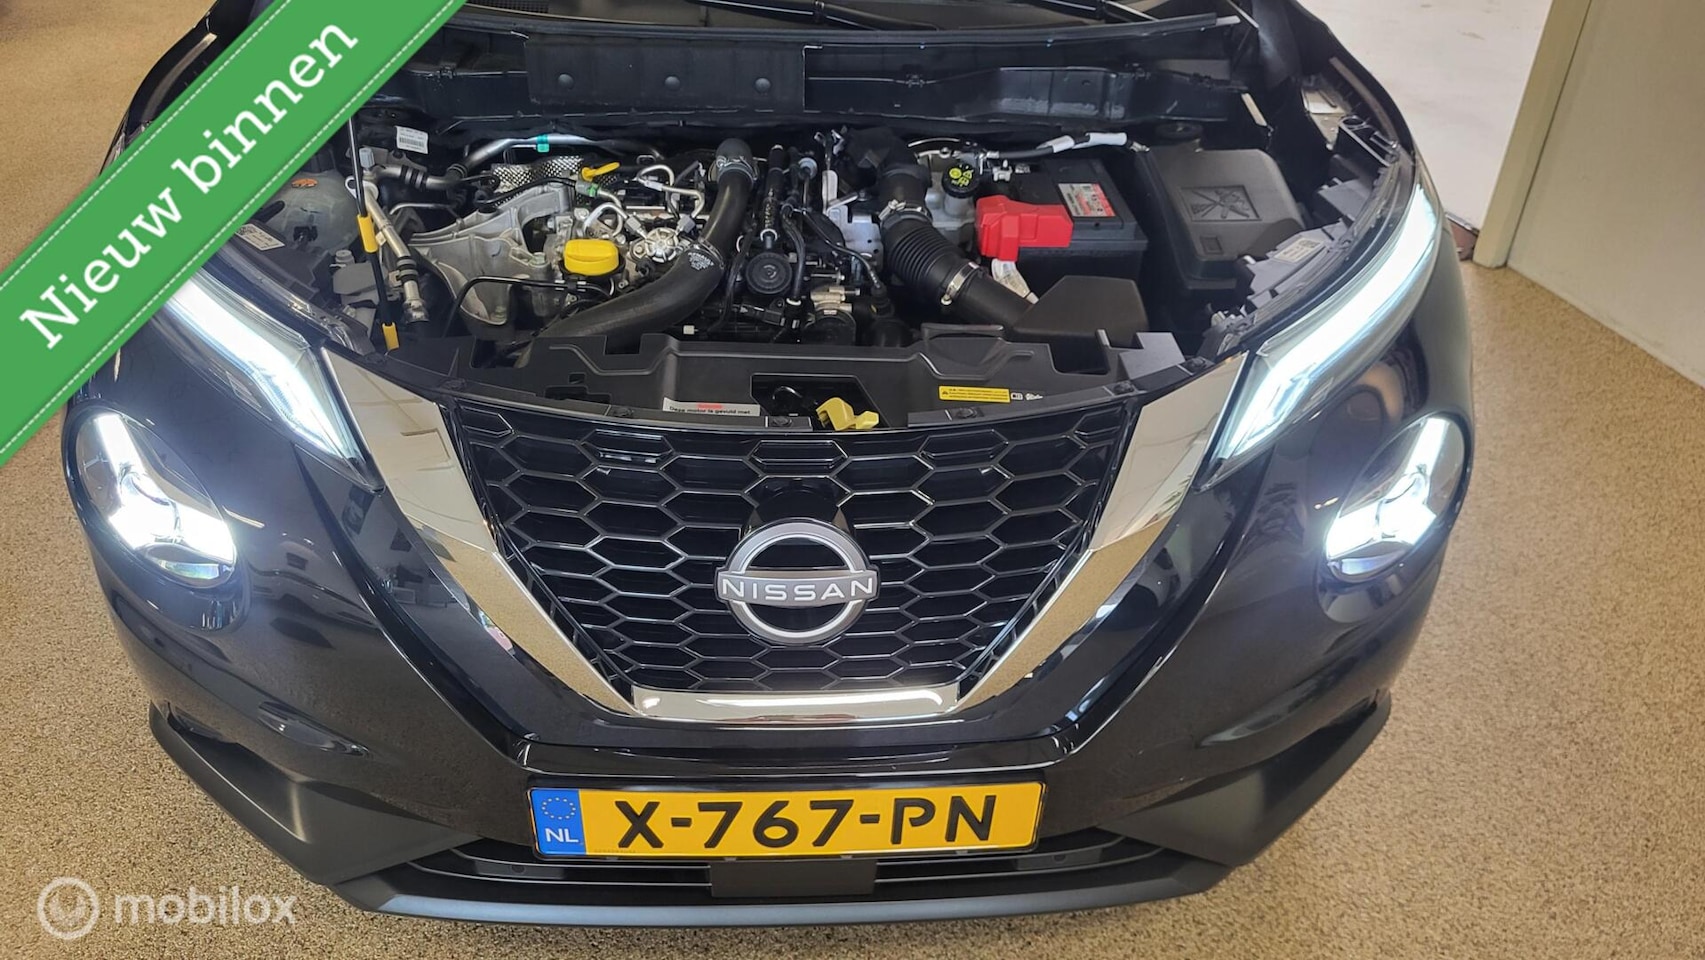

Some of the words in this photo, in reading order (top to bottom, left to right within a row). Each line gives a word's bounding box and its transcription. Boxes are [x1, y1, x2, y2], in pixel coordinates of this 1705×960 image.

[722, 577, 873, 601] NISSAN
[614, 795, 997, 849] X-767-PN
[545, 828, 579, 844] NL
